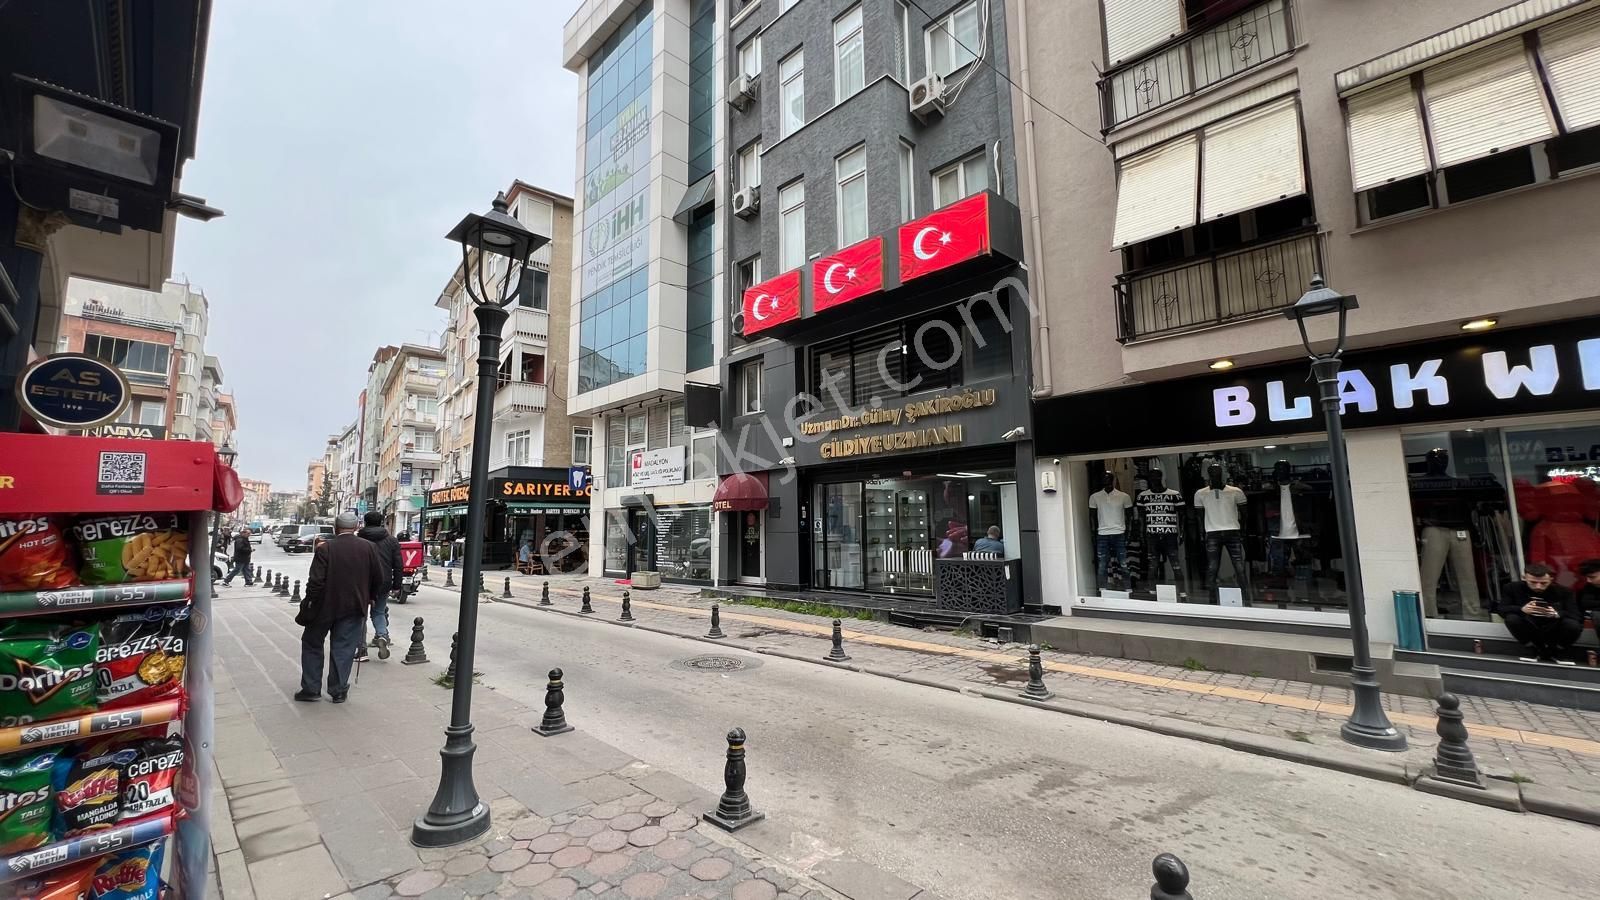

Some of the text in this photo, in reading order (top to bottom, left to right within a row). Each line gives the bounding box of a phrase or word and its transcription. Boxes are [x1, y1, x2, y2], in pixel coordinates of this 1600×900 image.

[50, 367, 101, 387] AS
[1213, 358, 1450, 428] BLAK
[503, 482, 571, 497] SARIYER
[0, 662, 94, 691] Doritos
